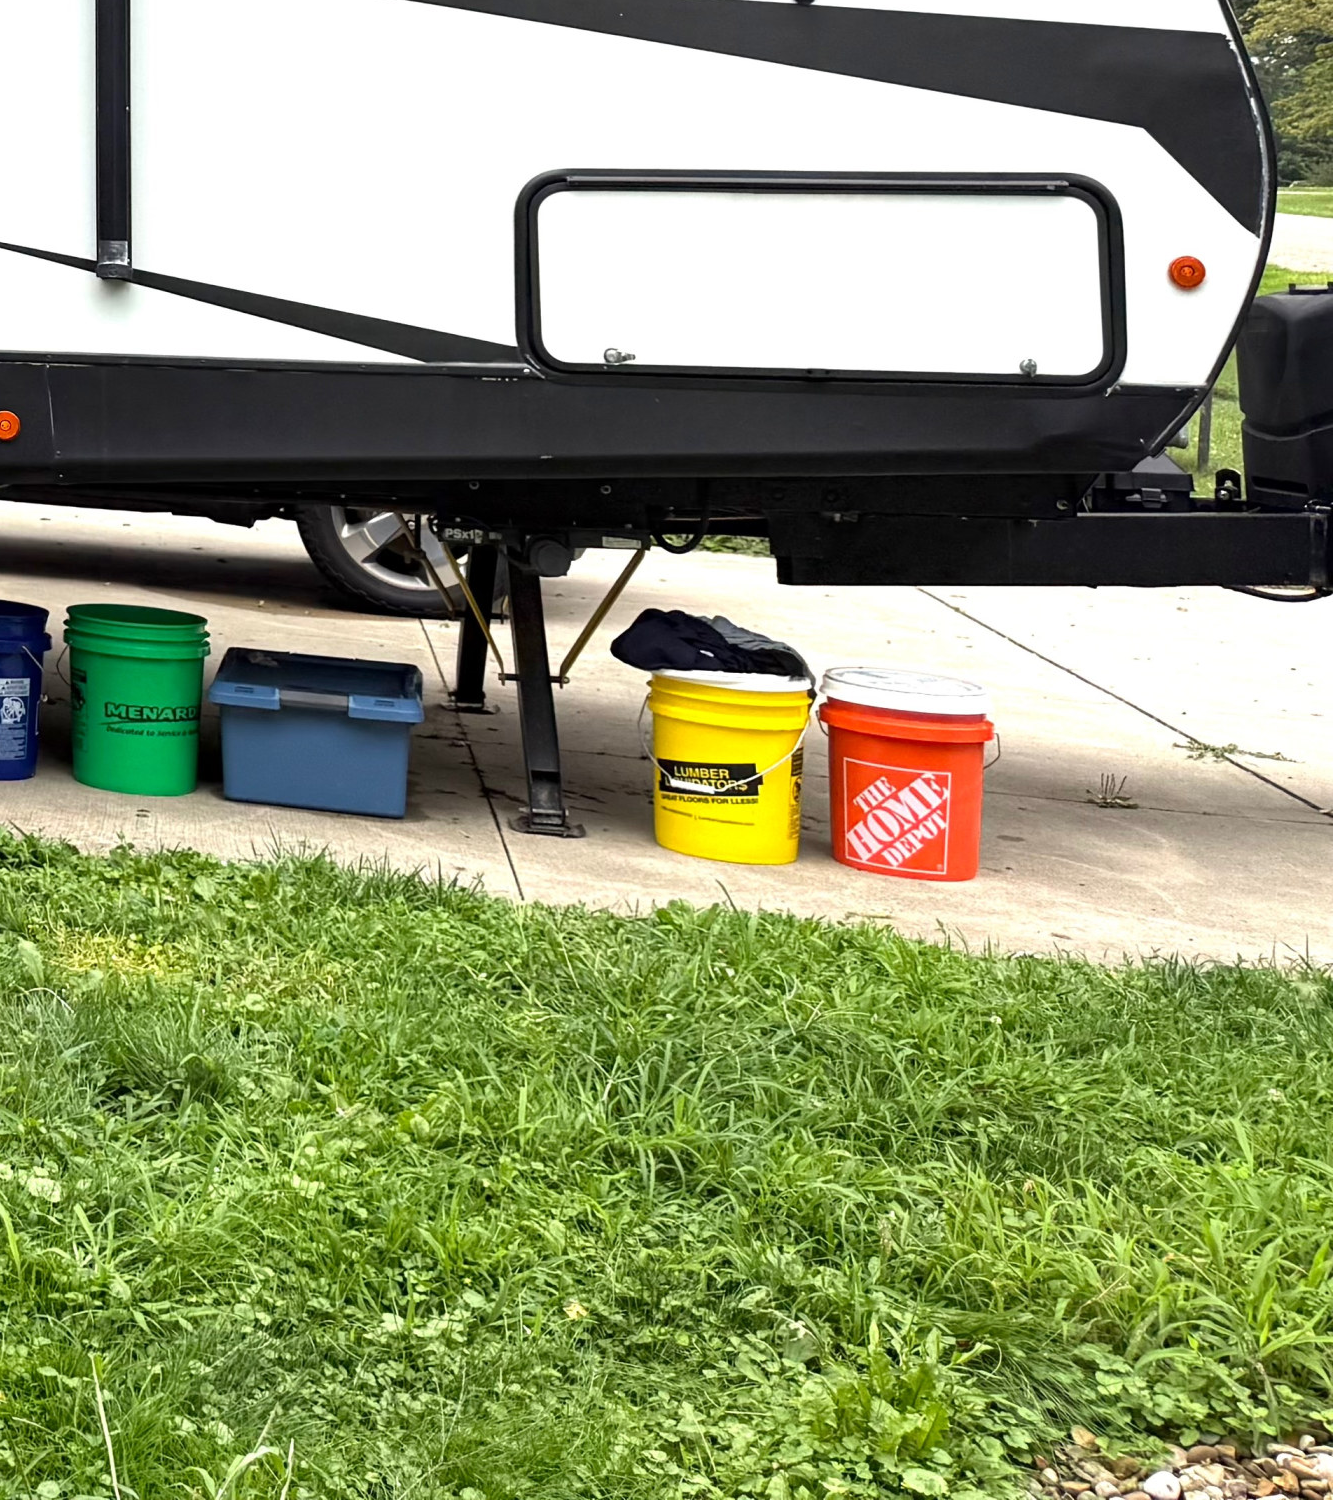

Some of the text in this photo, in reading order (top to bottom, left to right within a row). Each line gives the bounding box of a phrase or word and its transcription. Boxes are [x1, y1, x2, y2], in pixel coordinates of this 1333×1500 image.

[104, 702, 198, 722] MENARD
[674, 765, 730, 780] LUMBER
[853, 776, 897, 813] THE
[846, 772, 949, 861] HOME
[881, 810, 946, 867] DEPOT
